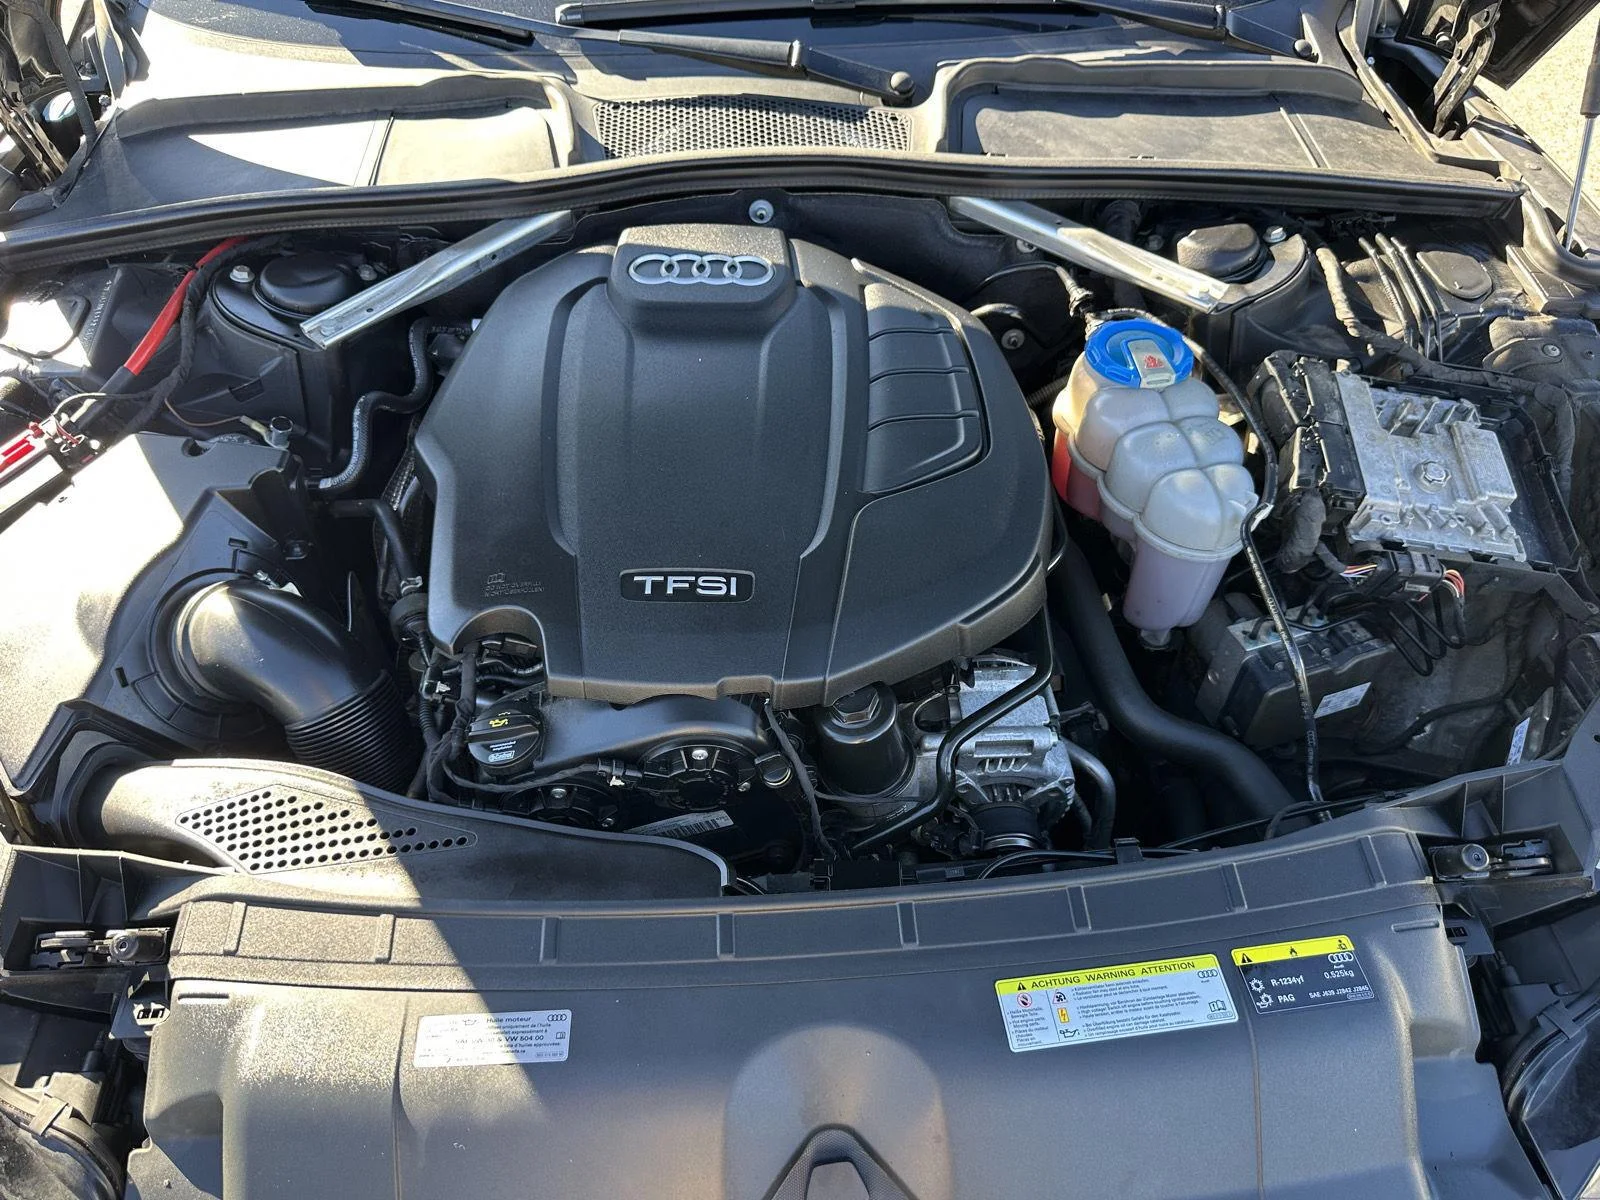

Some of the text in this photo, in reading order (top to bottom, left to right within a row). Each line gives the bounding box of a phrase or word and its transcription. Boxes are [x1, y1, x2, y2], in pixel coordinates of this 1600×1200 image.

[633, 576, 737, 596] TFSI
[1031, 961, 1195, 989] ACHTUNG WARNING ATTENTION
[1324, 969, 1354, 980] 0.525kg
[1271, 975, 1304, 987] R-1234yf
[1278, 994, 1295, 1002] PAG
